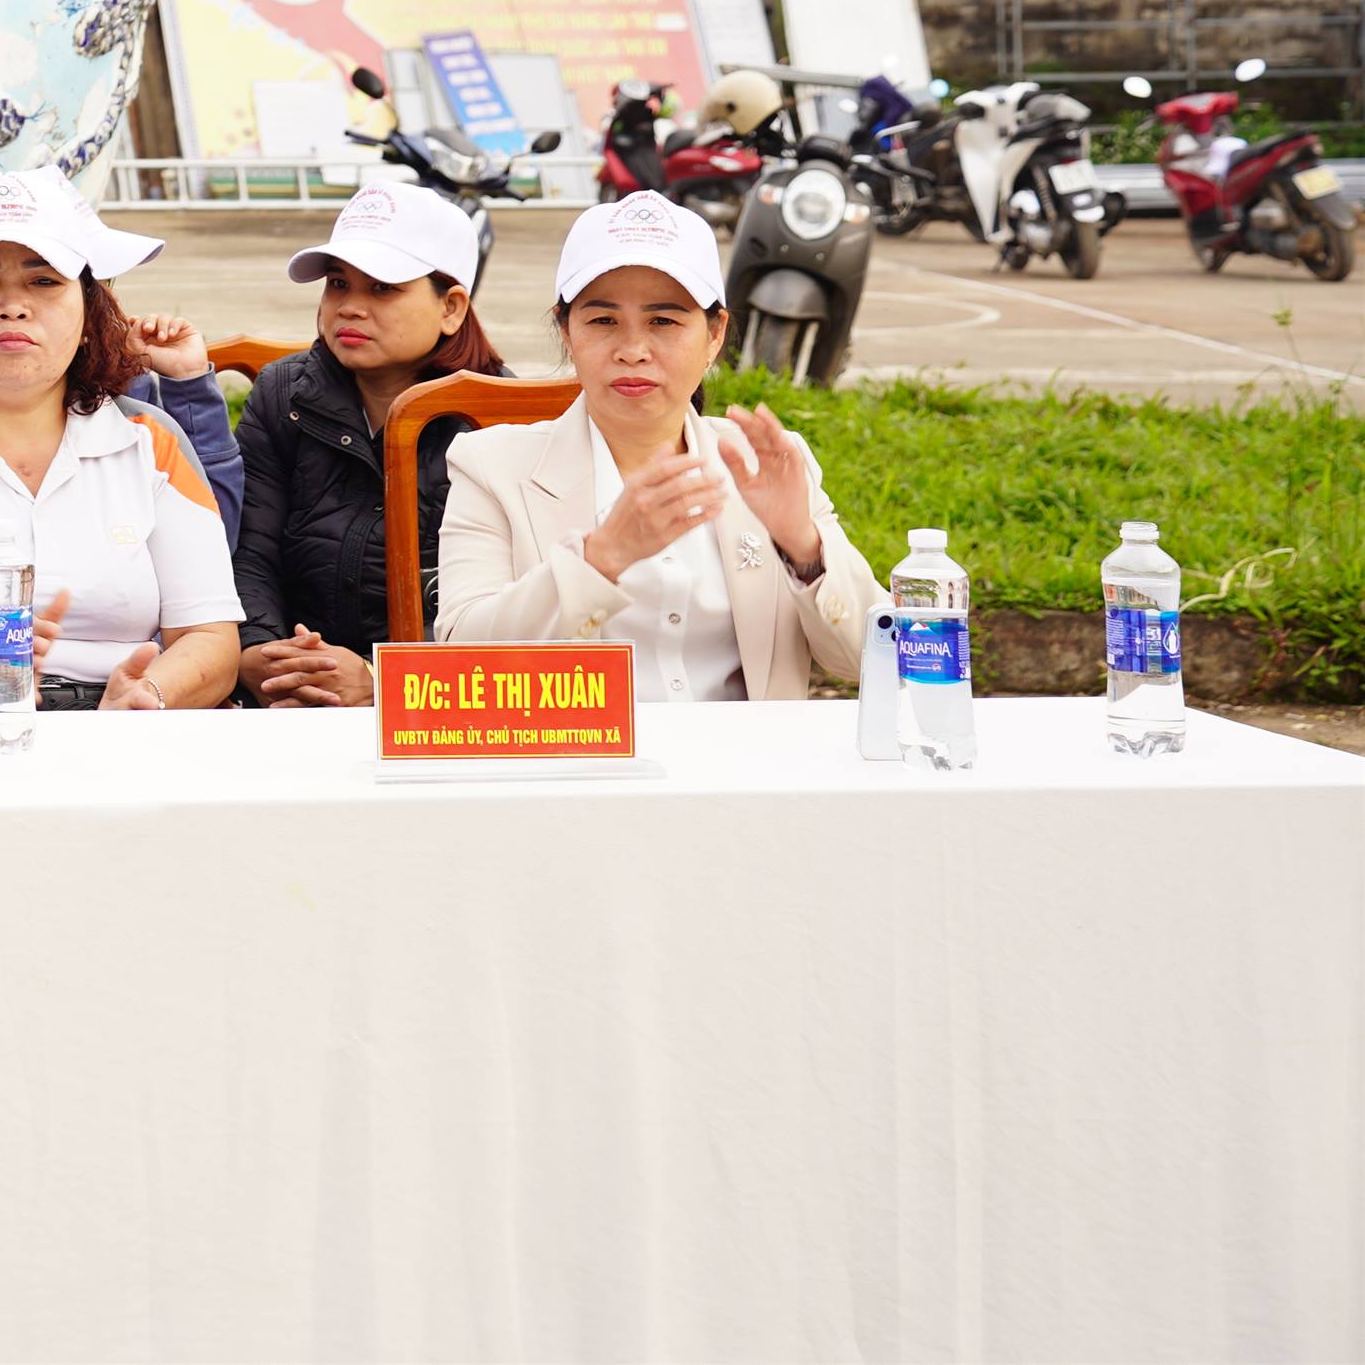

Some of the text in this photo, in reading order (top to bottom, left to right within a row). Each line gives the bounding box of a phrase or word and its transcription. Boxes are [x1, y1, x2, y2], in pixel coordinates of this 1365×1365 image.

[900, 640, 953, 657] AQUAFINA
[404, 665, 605, 717] Đ/c: LÊ THỊ XUÂN
[393, 725, 621, 747] UVBTV ĐẢNG ỦY, CHỦ TỊCH UBMTTQVN XÃ
